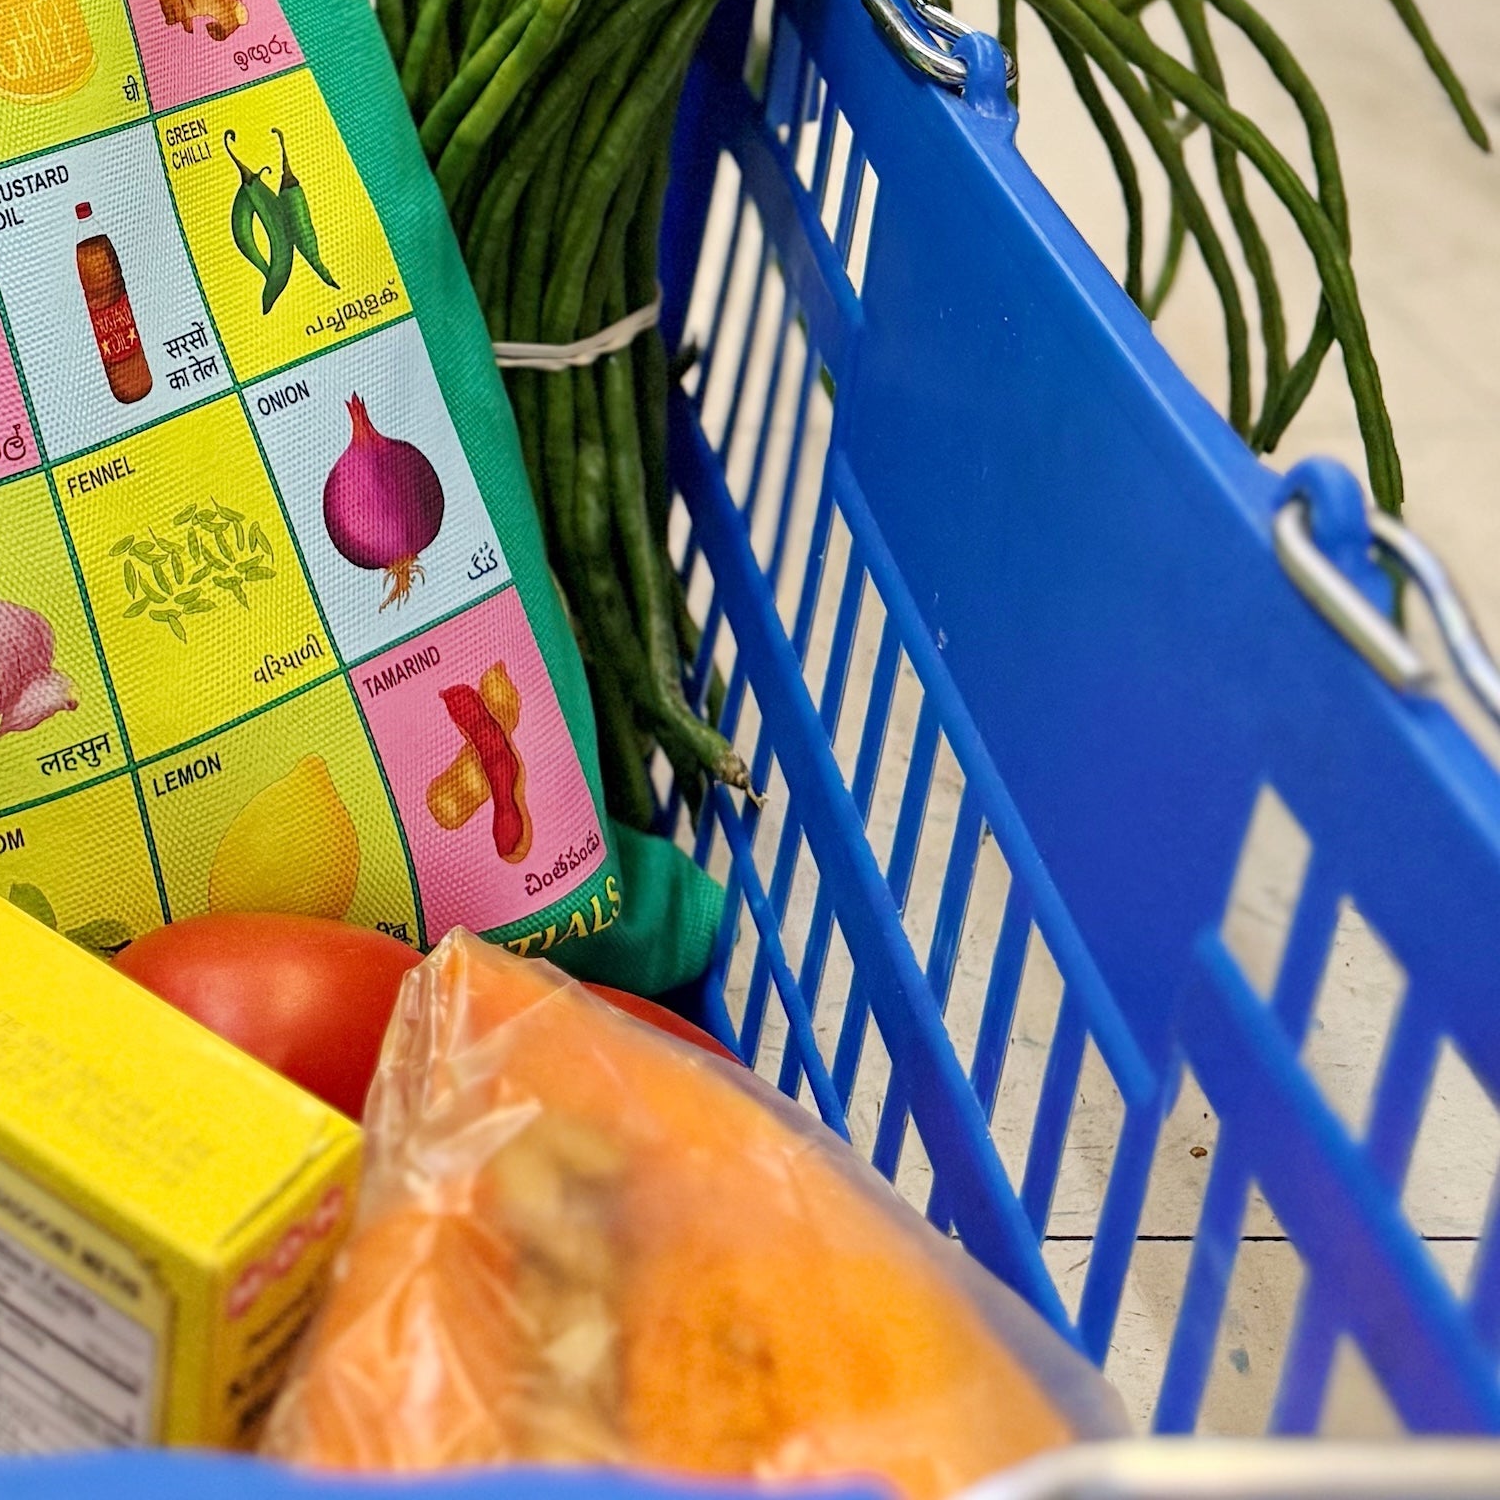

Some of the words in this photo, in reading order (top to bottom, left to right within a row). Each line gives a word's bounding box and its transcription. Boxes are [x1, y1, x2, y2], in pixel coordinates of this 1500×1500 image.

[122, 74, 141, 103] घी
[165, 117, 209, 148] GREEN
[171, 142, 213, 171] CHILLI
[162, 321, 209, 359] सरसों
[165, 366, 191, 391] का
[188, 355, 220, 383] तेल
[257, 379, 312, 417] ONION
[66, 455, 136, 499] FENNEL
[362, 644, 443, 700] TAMARIND
[36, 731, 112, 778] लहसुन
[152, 751, 223, 799] LEMON
[503, 876, 621, 957] TIALS
